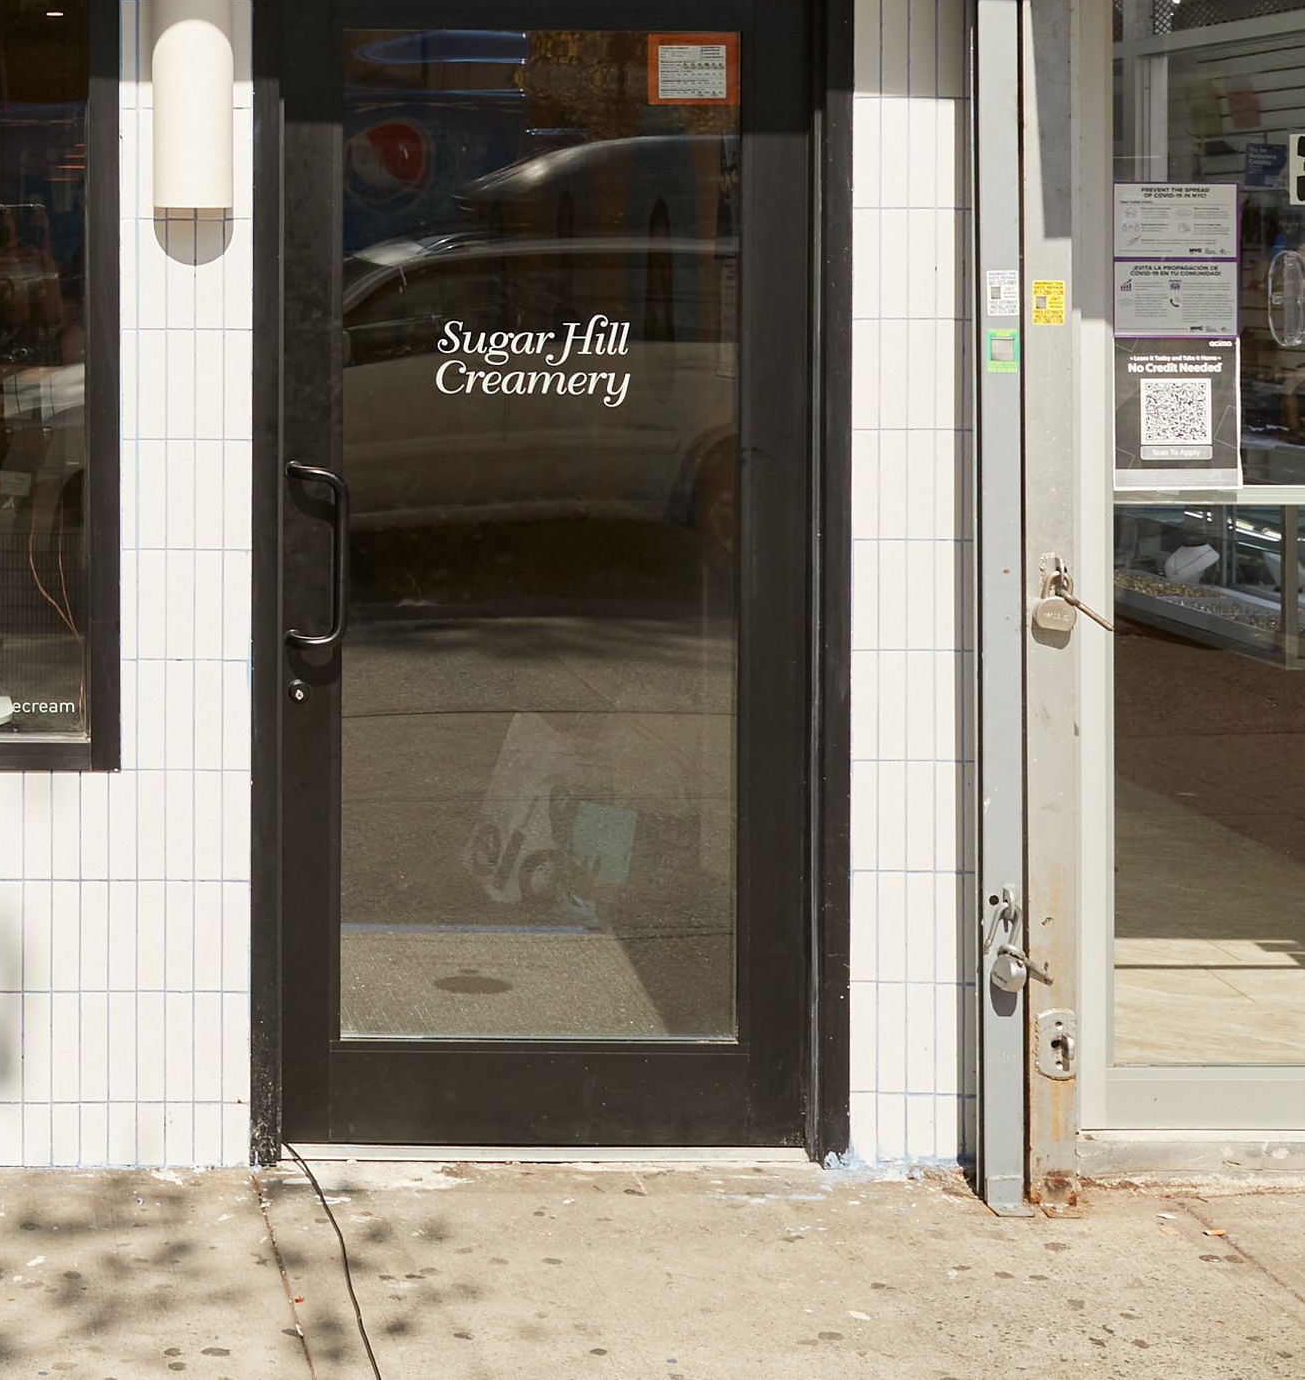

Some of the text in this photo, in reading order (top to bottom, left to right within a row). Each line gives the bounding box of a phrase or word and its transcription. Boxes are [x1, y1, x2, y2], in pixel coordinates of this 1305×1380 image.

[437, 314, 631, 366] Sugar Hill
[1127, 362, 1144, 372] No
[1145, 362, 1178, 372] Credit
[435, 359, 631, 408] Creamery
[1180, 449, 1200, 458] Apply
